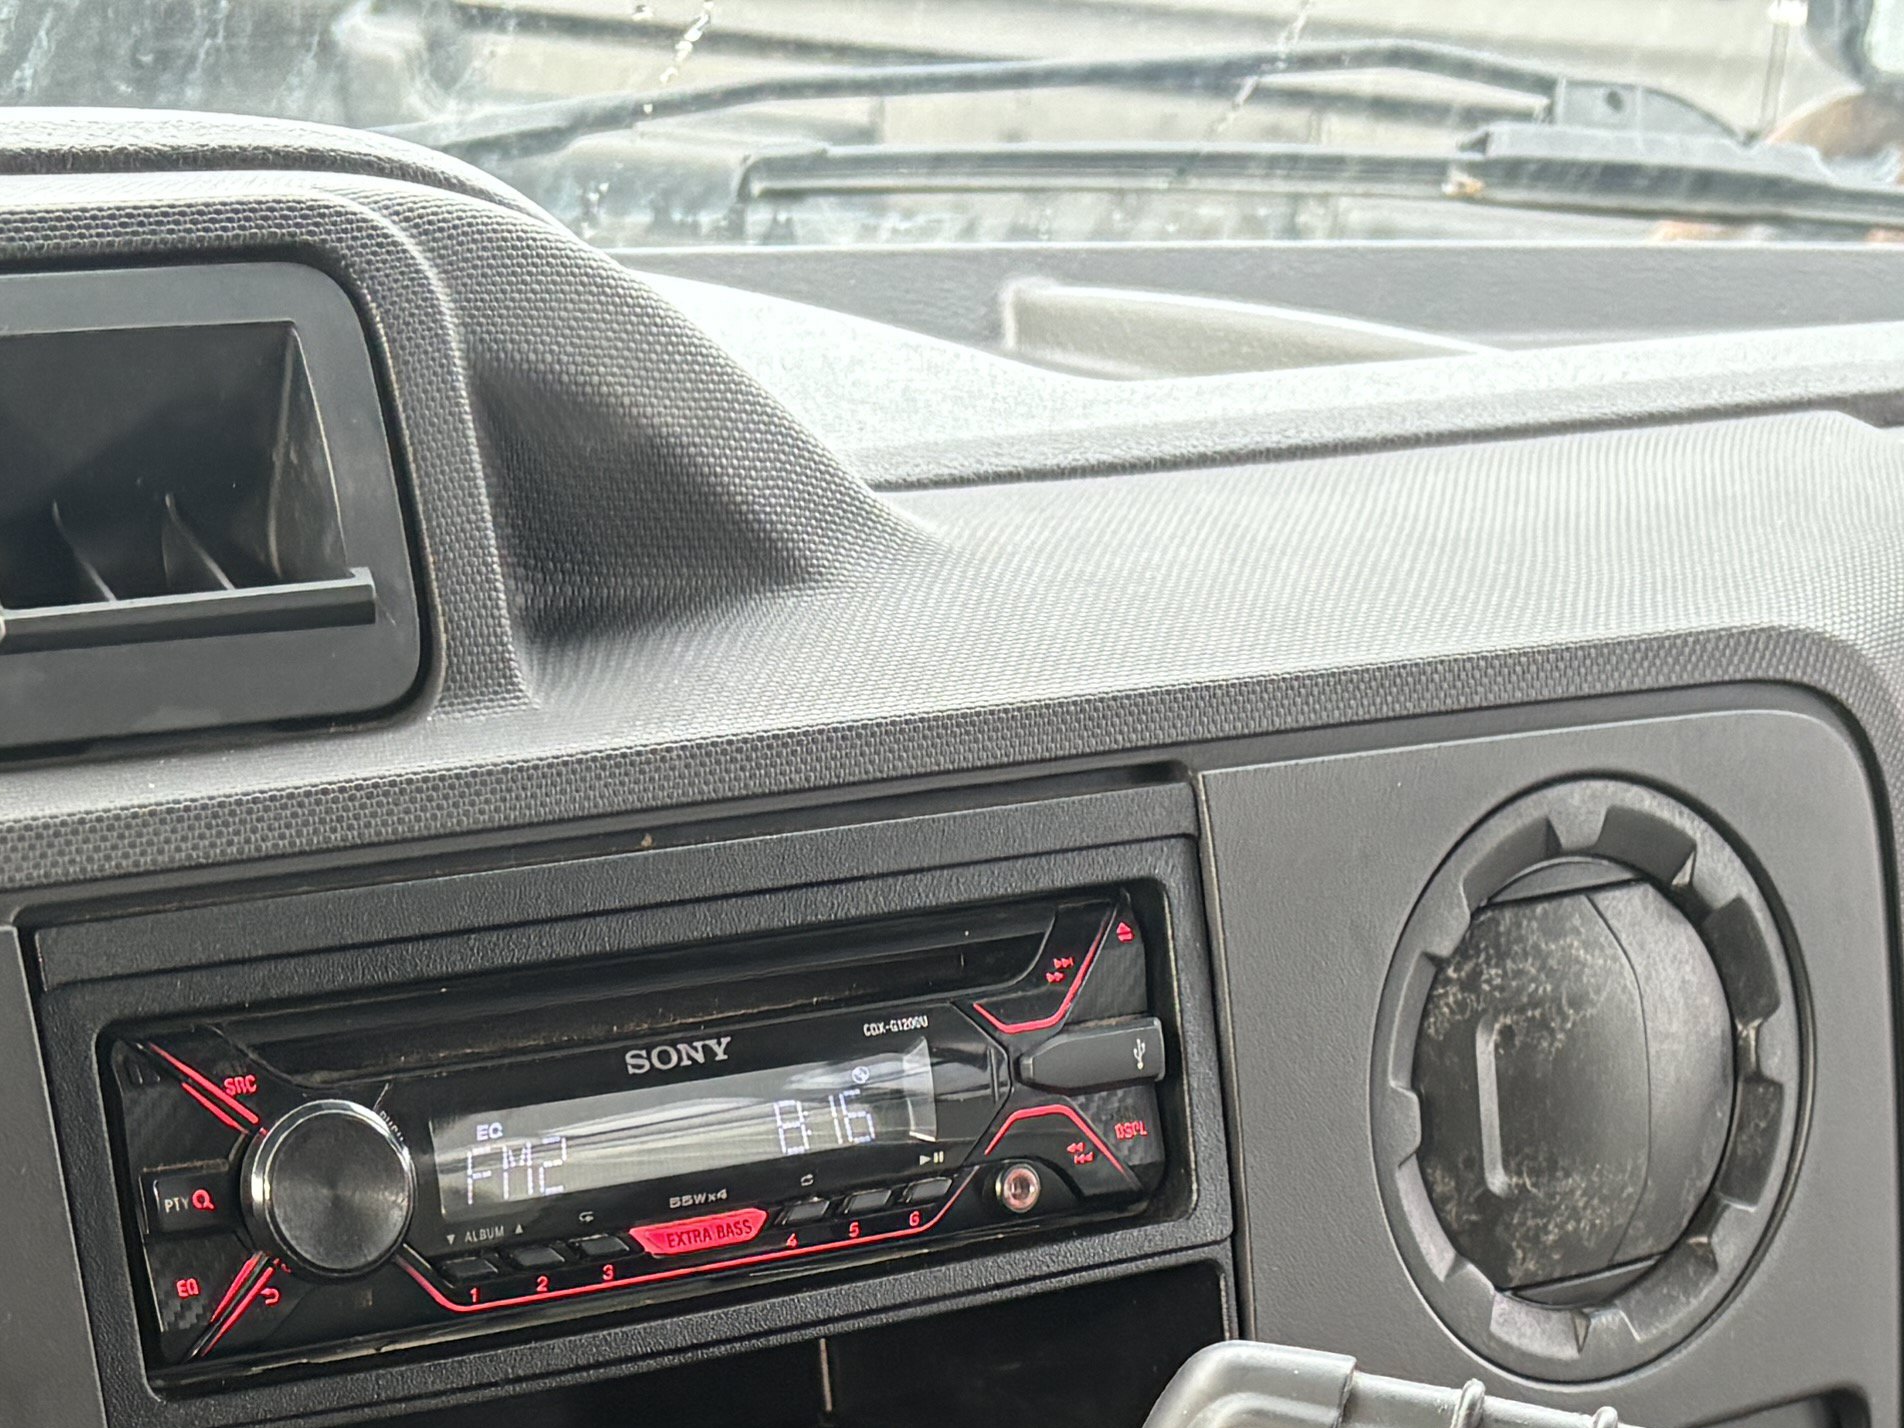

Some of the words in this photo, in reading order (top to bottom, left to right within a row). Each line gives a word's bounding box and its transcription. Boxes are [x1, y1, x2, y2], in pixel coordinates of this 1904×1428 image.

[625, 1036, 733, 1075] SONY
[224, 1074, 257, 1097] SRC
[774, 1088, 875, 1155] 8:16
[1114, 1120, 1148, 1140] DSPL
[467, 1137, 568, 1205] FM2
[164, 1197, 189, 1213] PTY
[908, 1211, 920, 1226] 6
[464, 1225, 504, 1242] ALBUM
[666, 1227, 712, 1248] EXTRA
[716, 1218, 753, 1239] BASS
[849, 1222, 860, 1238] 5
[785, 1233, 798, 1247] 4
[602, 1264, 615, 1280] 3
[176, 1278, 199, 1298] EQ
[536, 1275, 549, 1292] 2
[469, 1287, 479, 1303] 1
